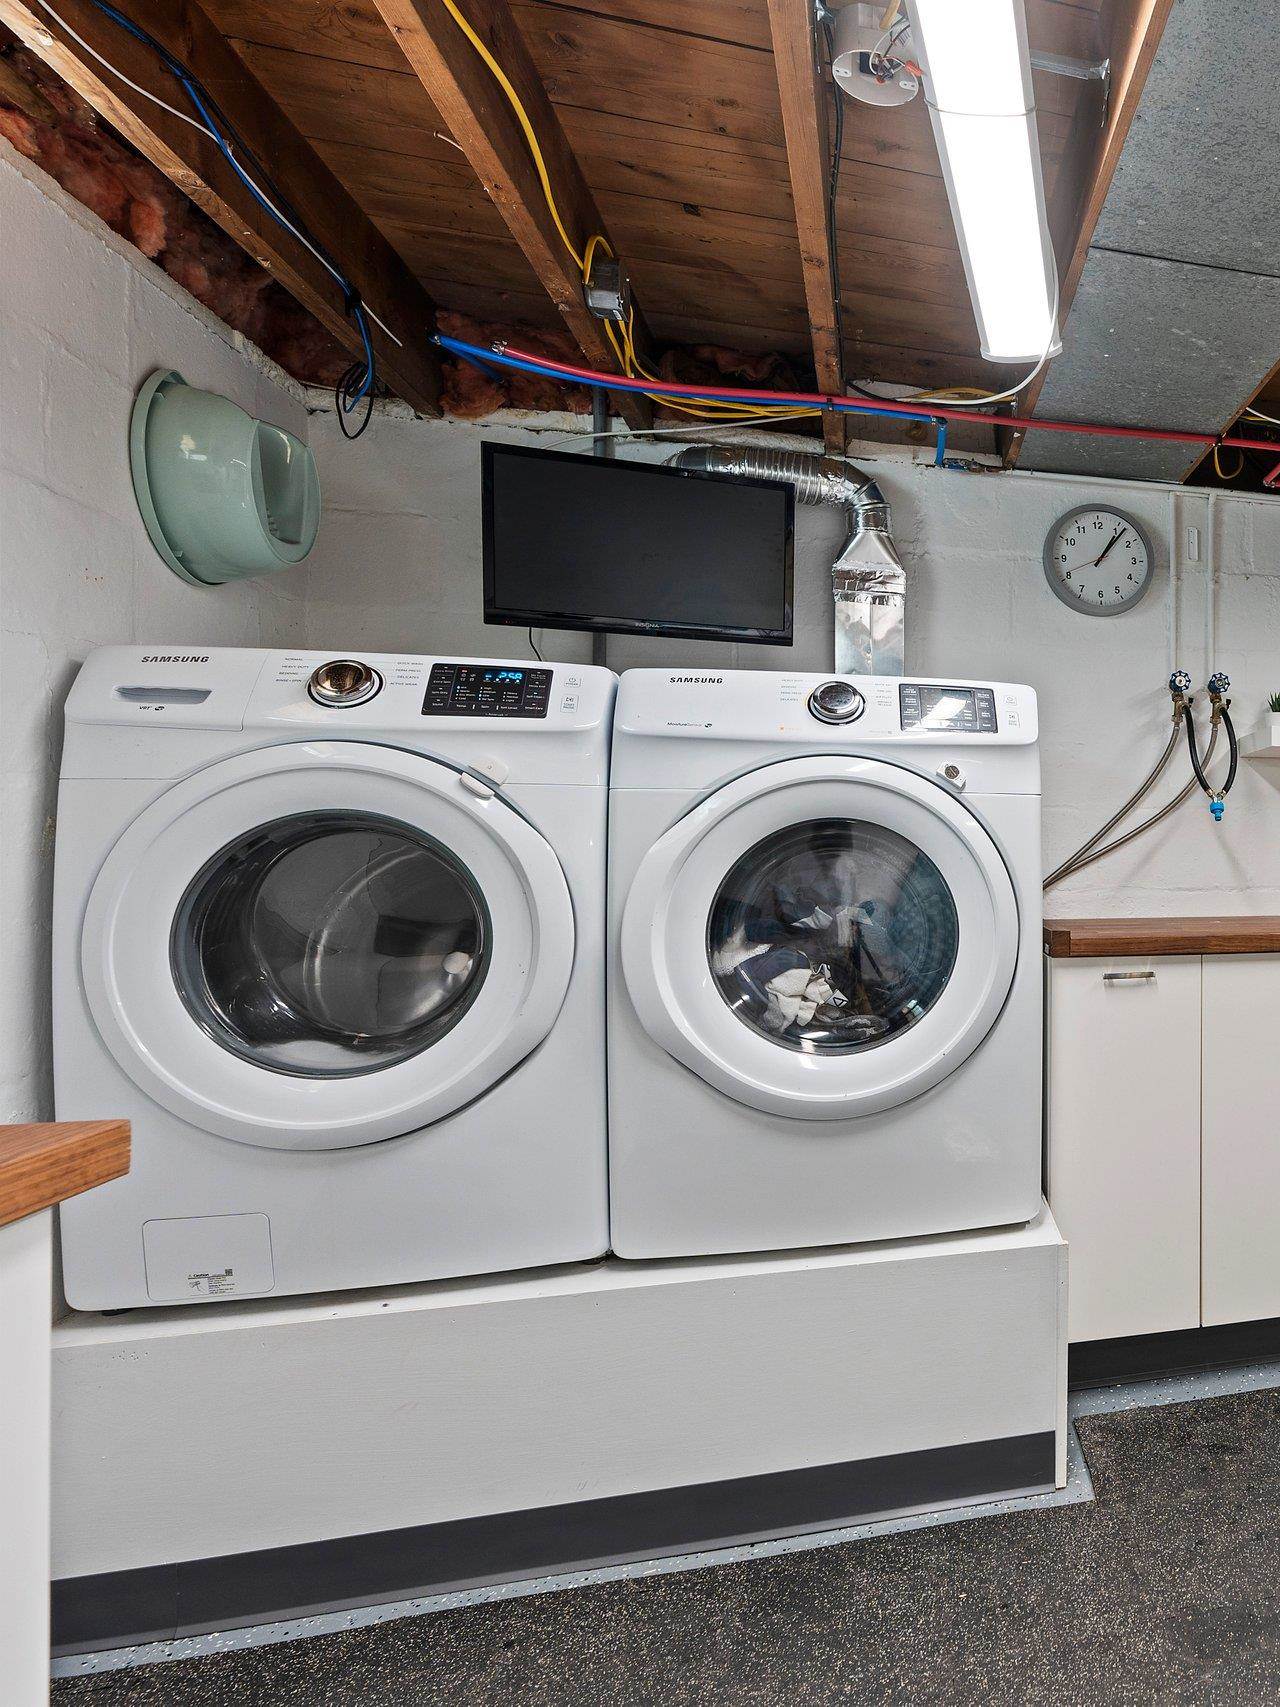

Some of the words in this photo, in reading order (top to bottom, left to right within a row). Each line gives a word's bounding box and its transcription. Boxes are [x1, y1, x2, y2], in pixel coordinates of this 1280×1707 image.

[1076, 526, 1086, 534] 11
[1092, 522, 1103, 530] 12
[1065, 538, 1076, 546] 10
[1125, 541, 1131, 549] 2
[1131, 557, 1137, 565] 3
[1127, 573, 1133, 581] 4
[1098, 590, 1104, 598] 6
[1115, 586, 1120, 594] 5
[141, 655, 210, 663] SAMSUNG
[669, 676, 723, 684] SAMSUNG
